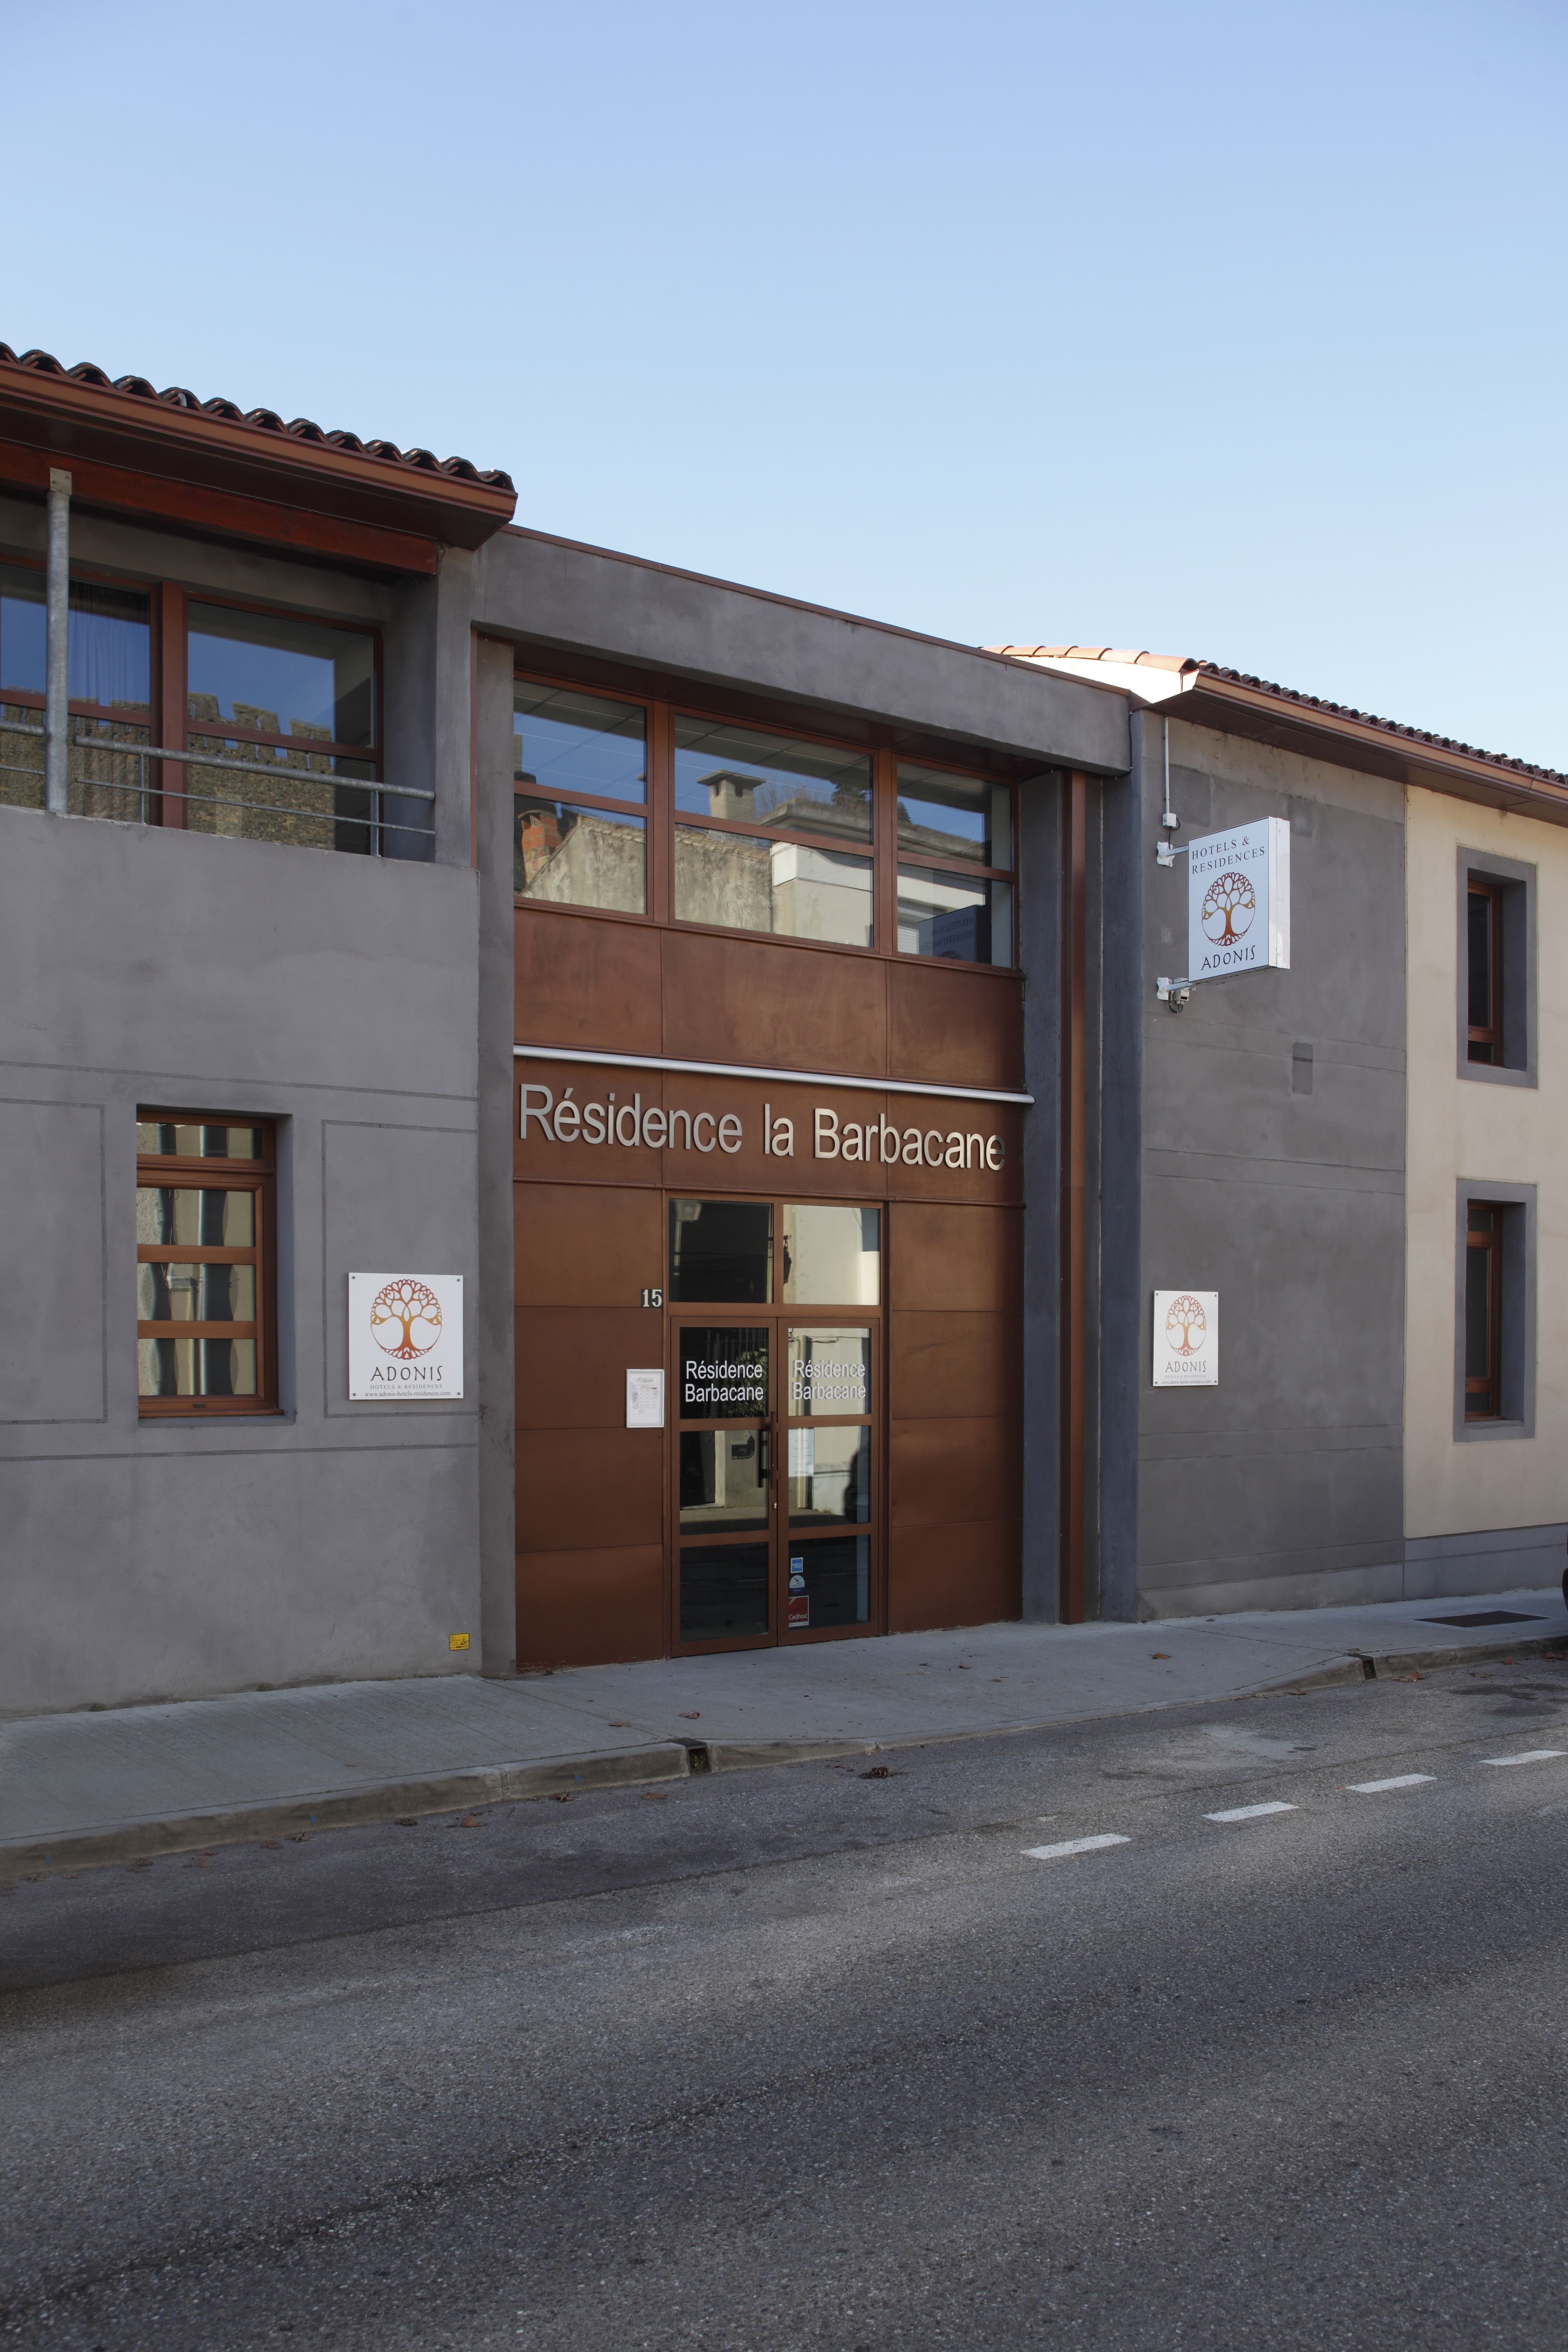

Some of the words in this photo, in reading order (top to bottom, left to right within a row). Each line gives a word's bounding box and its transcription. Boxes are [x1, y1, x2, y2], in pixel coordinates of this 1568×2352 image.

[1191, 839, 1236, 860] HOTELS
[1242, 836, 1250, 846] &
[1191, 846, 1265, 874] RESIDENCES
[1201, 945, 1256, 970] ADONIS
[519, 1083, 742, 1154] Résidence
[763, 1103, 794, 1157] la
[814, 1108, 1006, 1171] Barbacane
[642, 1289, 662, 1307] 15
[370, 1366, 443, 1381] ADONIS
[686, 1360, 763, 1379] Résidence
[794, 1360, 865, 1377] Résidence
[1165, 1361, 1206, 1372] ADONIS
[685, 1384, 763, 1402] Barbacane
[794, 1382, 866, 1400] Barbacane
